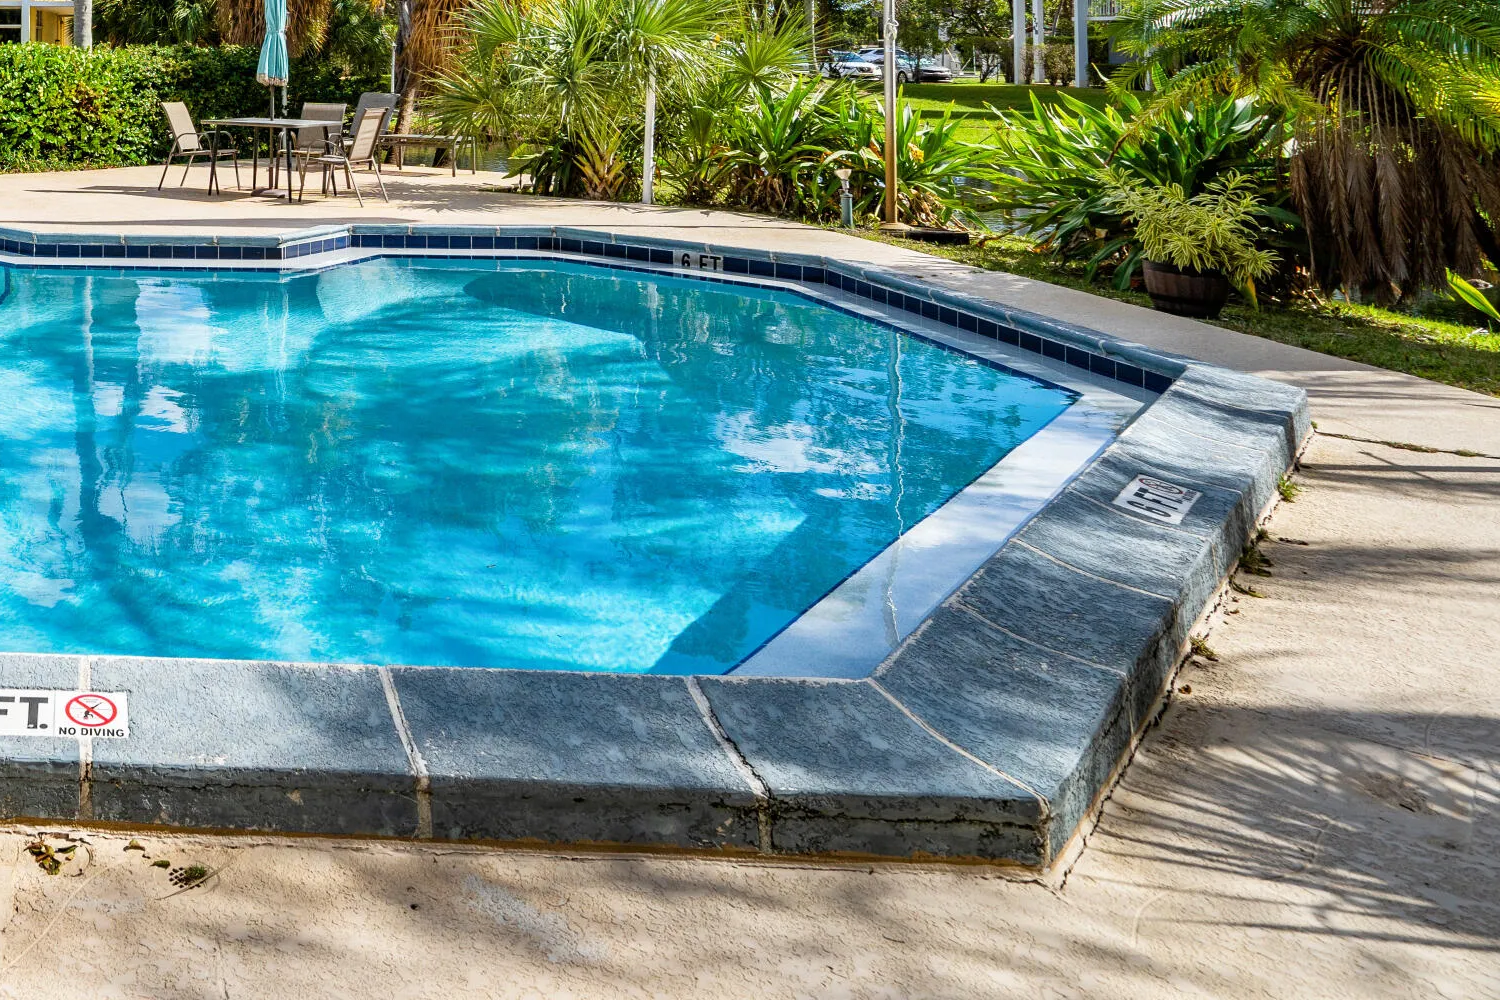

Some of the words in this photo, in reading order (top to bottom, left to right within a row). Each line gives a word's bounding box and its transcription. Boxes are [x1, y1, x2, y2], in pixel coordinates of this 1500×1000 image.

[681, 253, 691, 267] 6
[699, 254, 721, 270] FT
[58, 727, 77, 736] NO
[81, 727, 125, 737] DIVING
